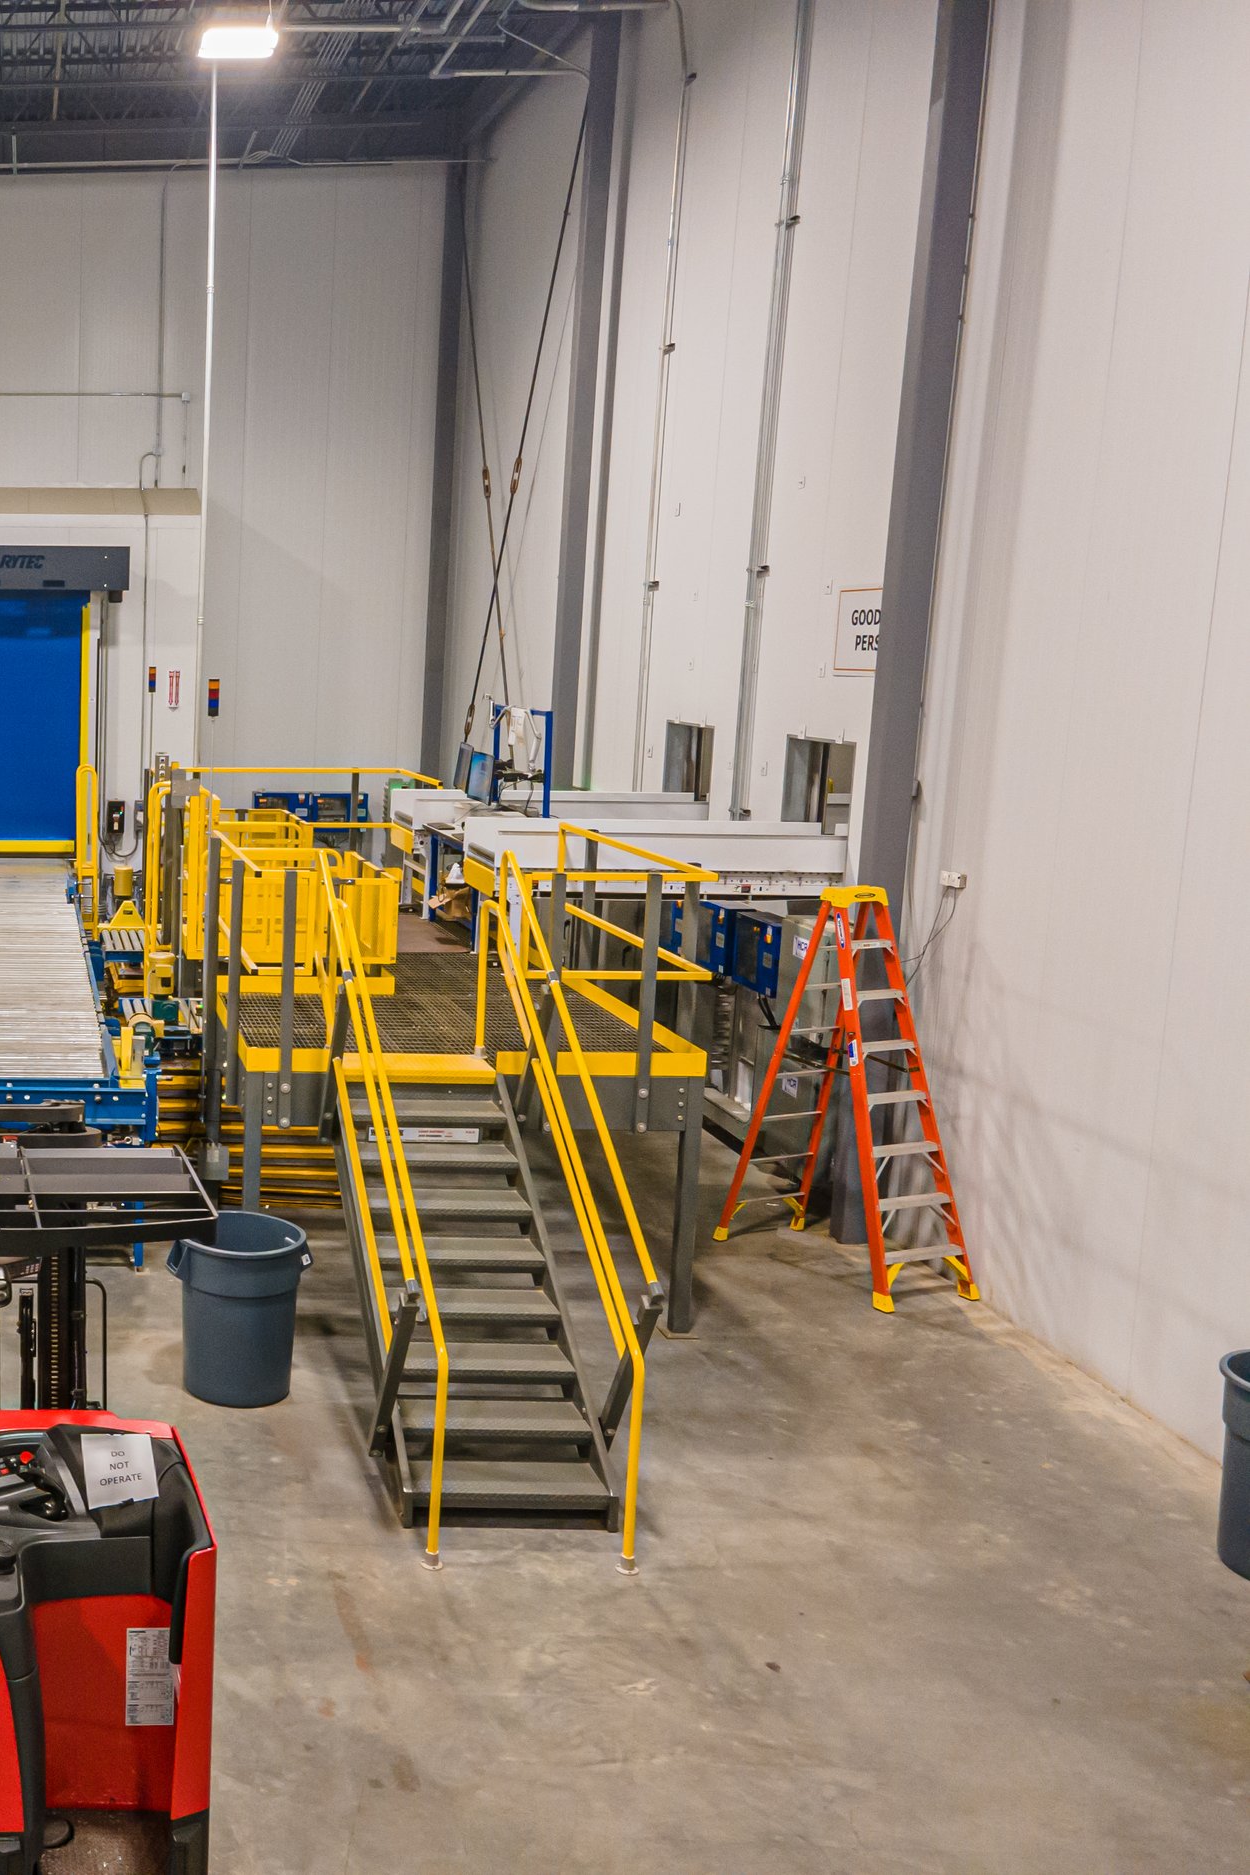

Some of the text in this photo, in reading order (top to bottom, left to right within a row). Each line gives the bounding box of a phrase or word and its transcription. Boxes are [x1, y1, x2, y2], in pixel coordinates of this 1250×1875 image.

[0, 554, 46, 570] RYTEC
[851, 608, 882, 626] GOOD
[110, 1450, 125, 1458] DO
[109, 1460, 130, 1471] NOT
[99, 1472, 143, 1487] OPERATE
